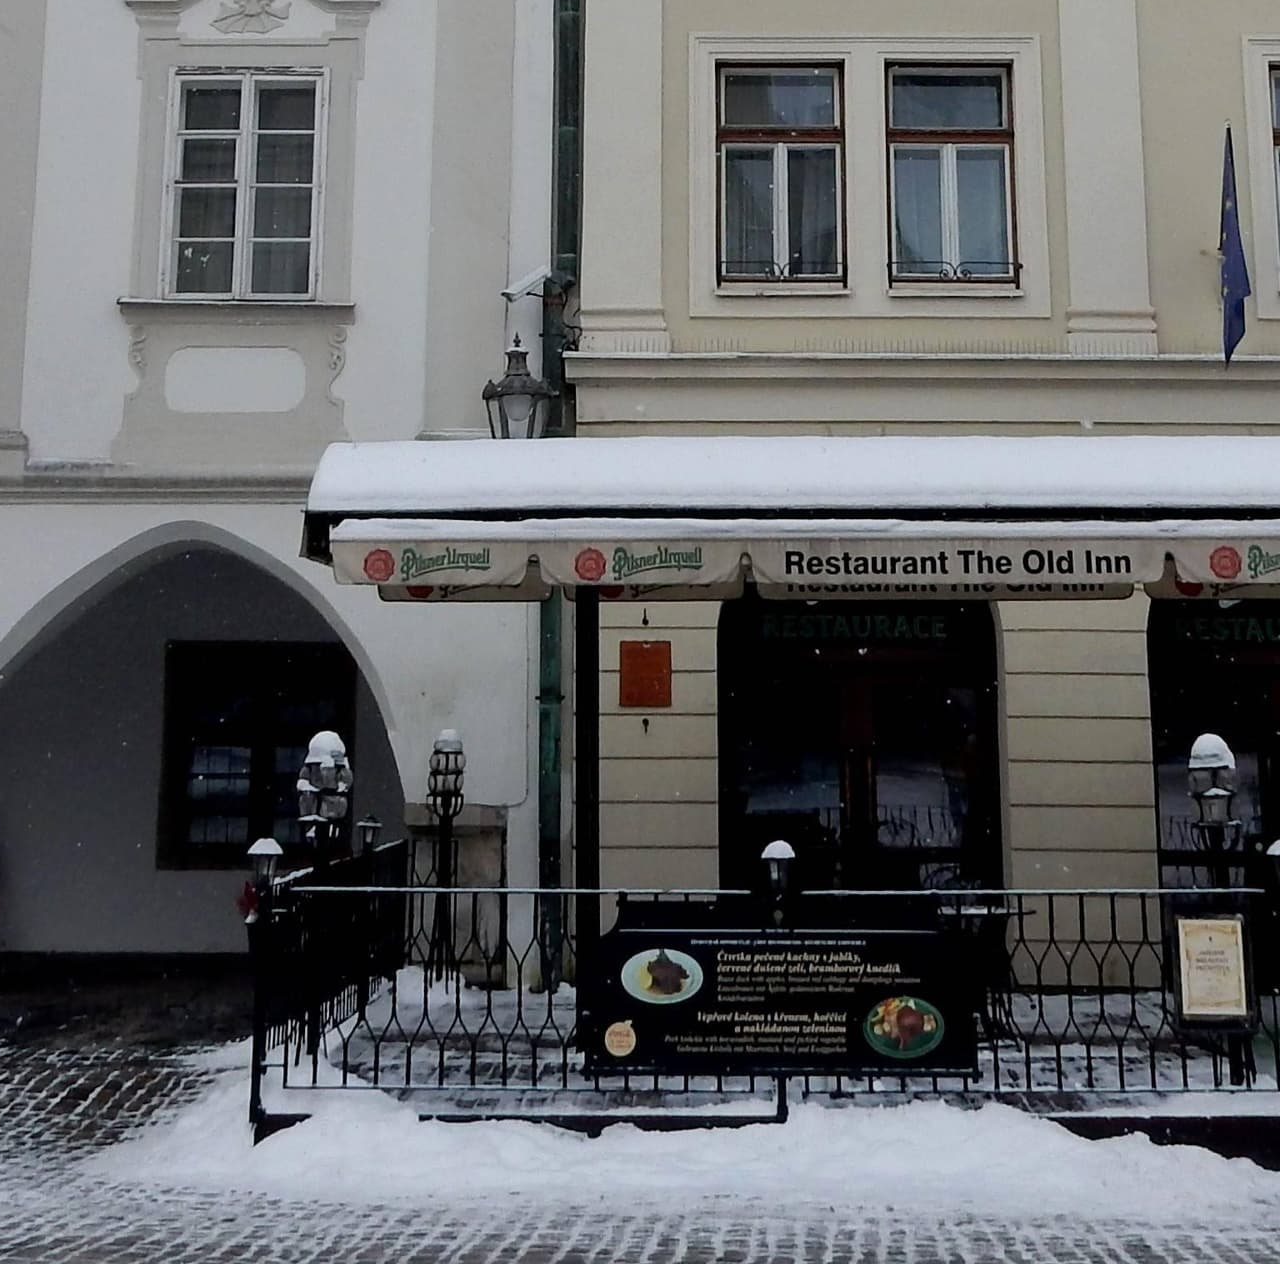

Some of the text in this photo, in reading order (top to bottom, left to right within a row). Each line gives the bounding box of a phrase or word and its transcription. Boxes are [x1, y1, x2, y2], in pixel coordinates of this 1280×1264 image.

[401, 546, 490, 581] Pilsner Urquell
[612, 546, 702, 581] Pilsner Urquell
[784, 550, 1132, 575] Restaurant The Old Inn
[762, 615, 947, 638] RESTAURACE
